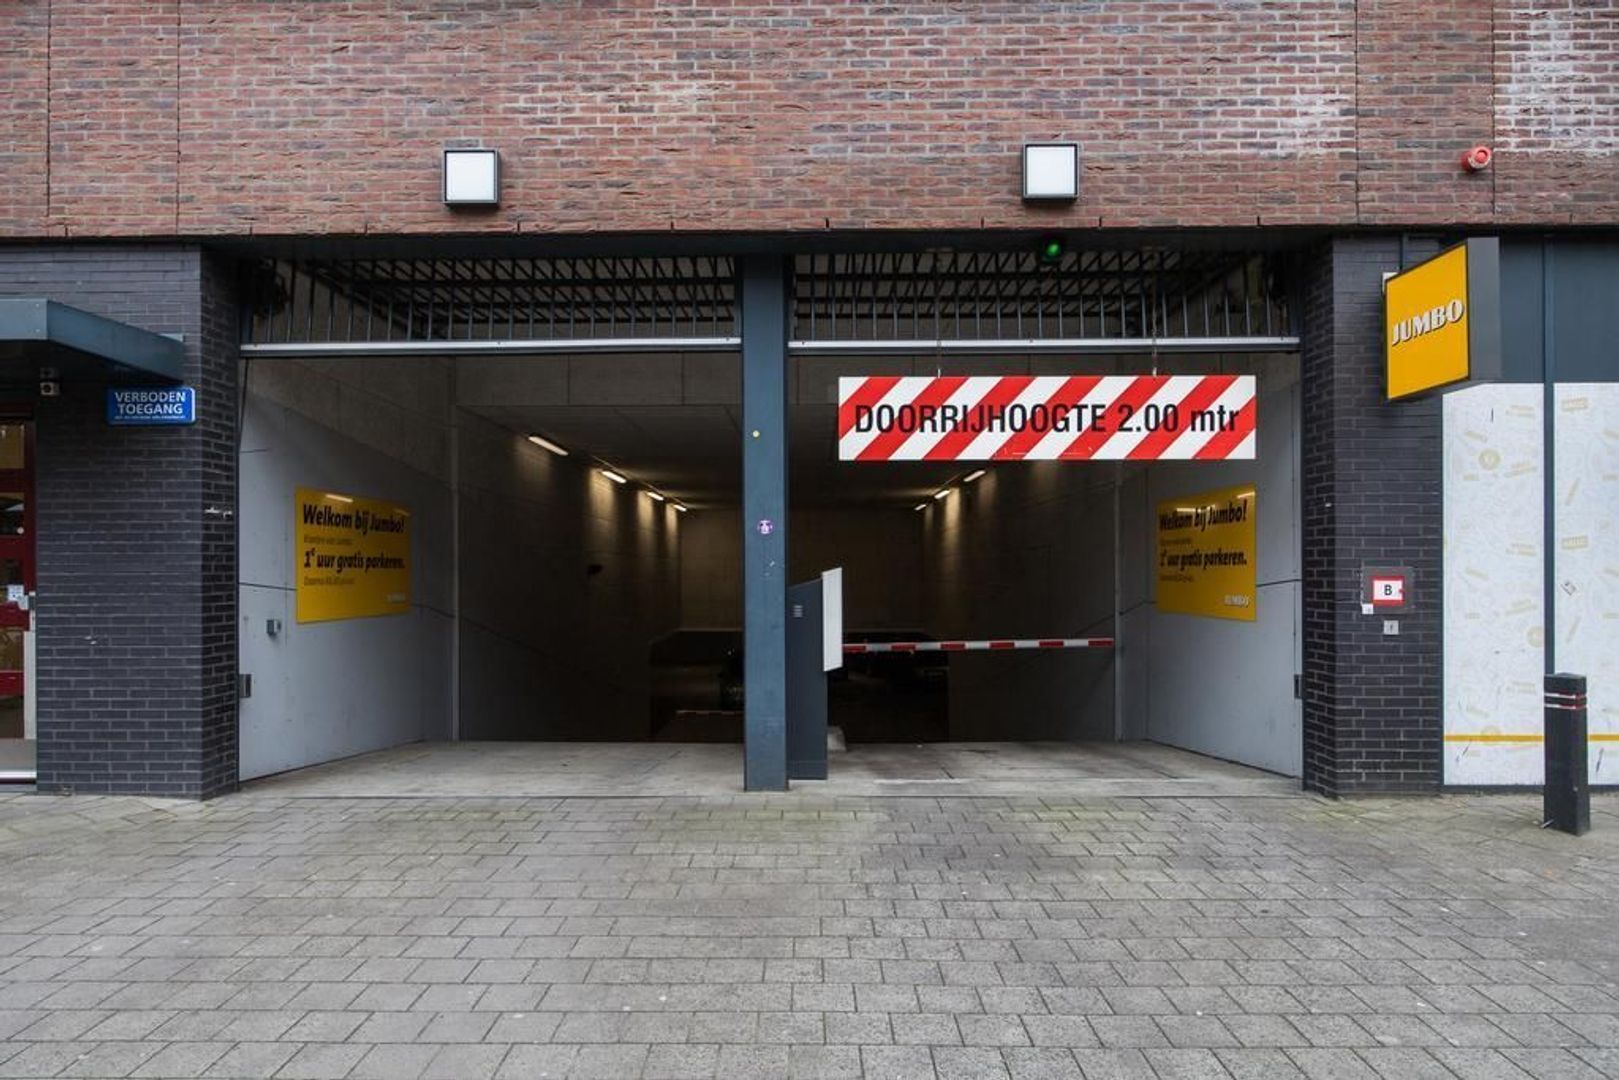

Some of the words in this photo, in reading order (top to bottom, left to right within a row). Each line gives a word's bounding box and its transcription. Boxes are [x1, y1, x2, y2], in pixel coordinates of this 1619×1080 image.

[1391, 298, 1465, 347] JUMBO
[114, 391, 186, 403] VERBODEN
[117, 403, 183, 415] TOEGANG
[854, 403, 1107, 433] DOORRIJHOOGTE
[1116, 403, 1179, 433] 2.00
[1189, 404, 1240, 432] mtr
[303, 504, 352, 529] Welkom
[355, 509, 369, 536] bij
[369, 512, 405, 533] Jumbo!
[1193, 505, 1207, 532] bij
[1207, 498, 1248, 526] Jumbo!
[316, 554, 335, 569] uur
[335, 550, 364, 574] gratis
[364, 551, 406, 574] parkeren.
[1202, 547, 1248, 571] parkeren.
[1384, 584, 1393, 596] B
